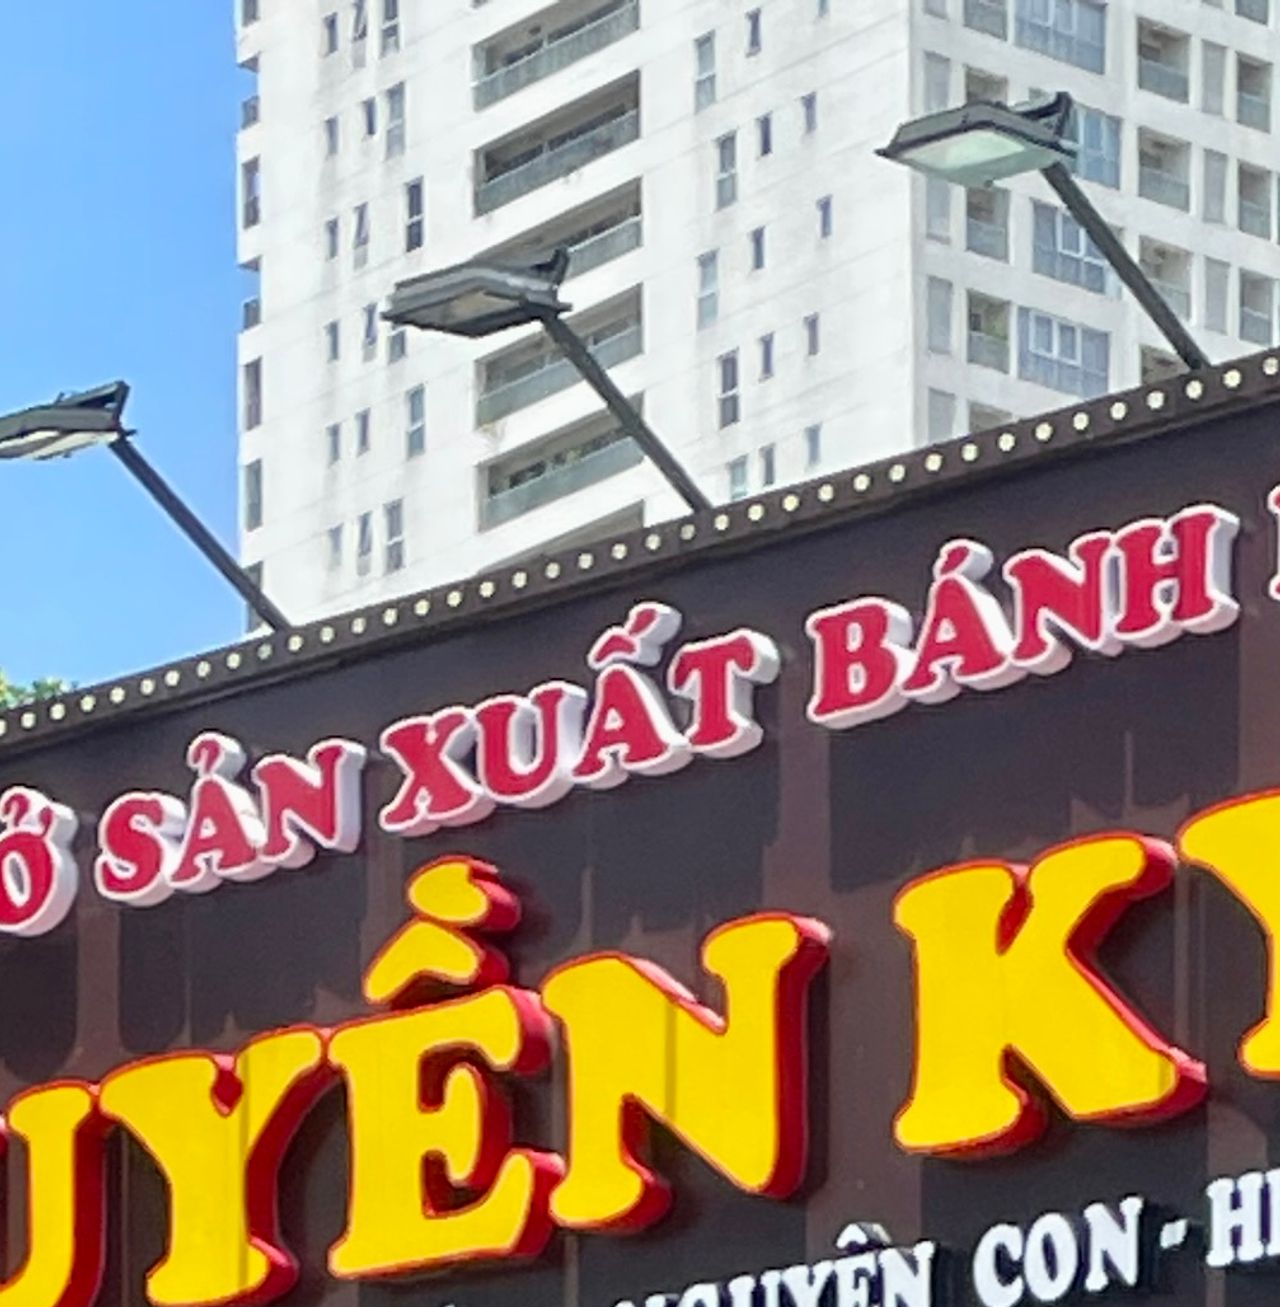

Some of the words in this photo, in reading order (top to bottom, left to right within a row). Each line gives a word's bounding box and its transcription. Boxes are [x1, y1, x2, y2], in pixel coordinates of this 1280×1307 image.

[95, 733, 364, 907] SẢN
[379, 603, 779, 834] XUẤT
[808, 500, 1240, 730] BÁNH
